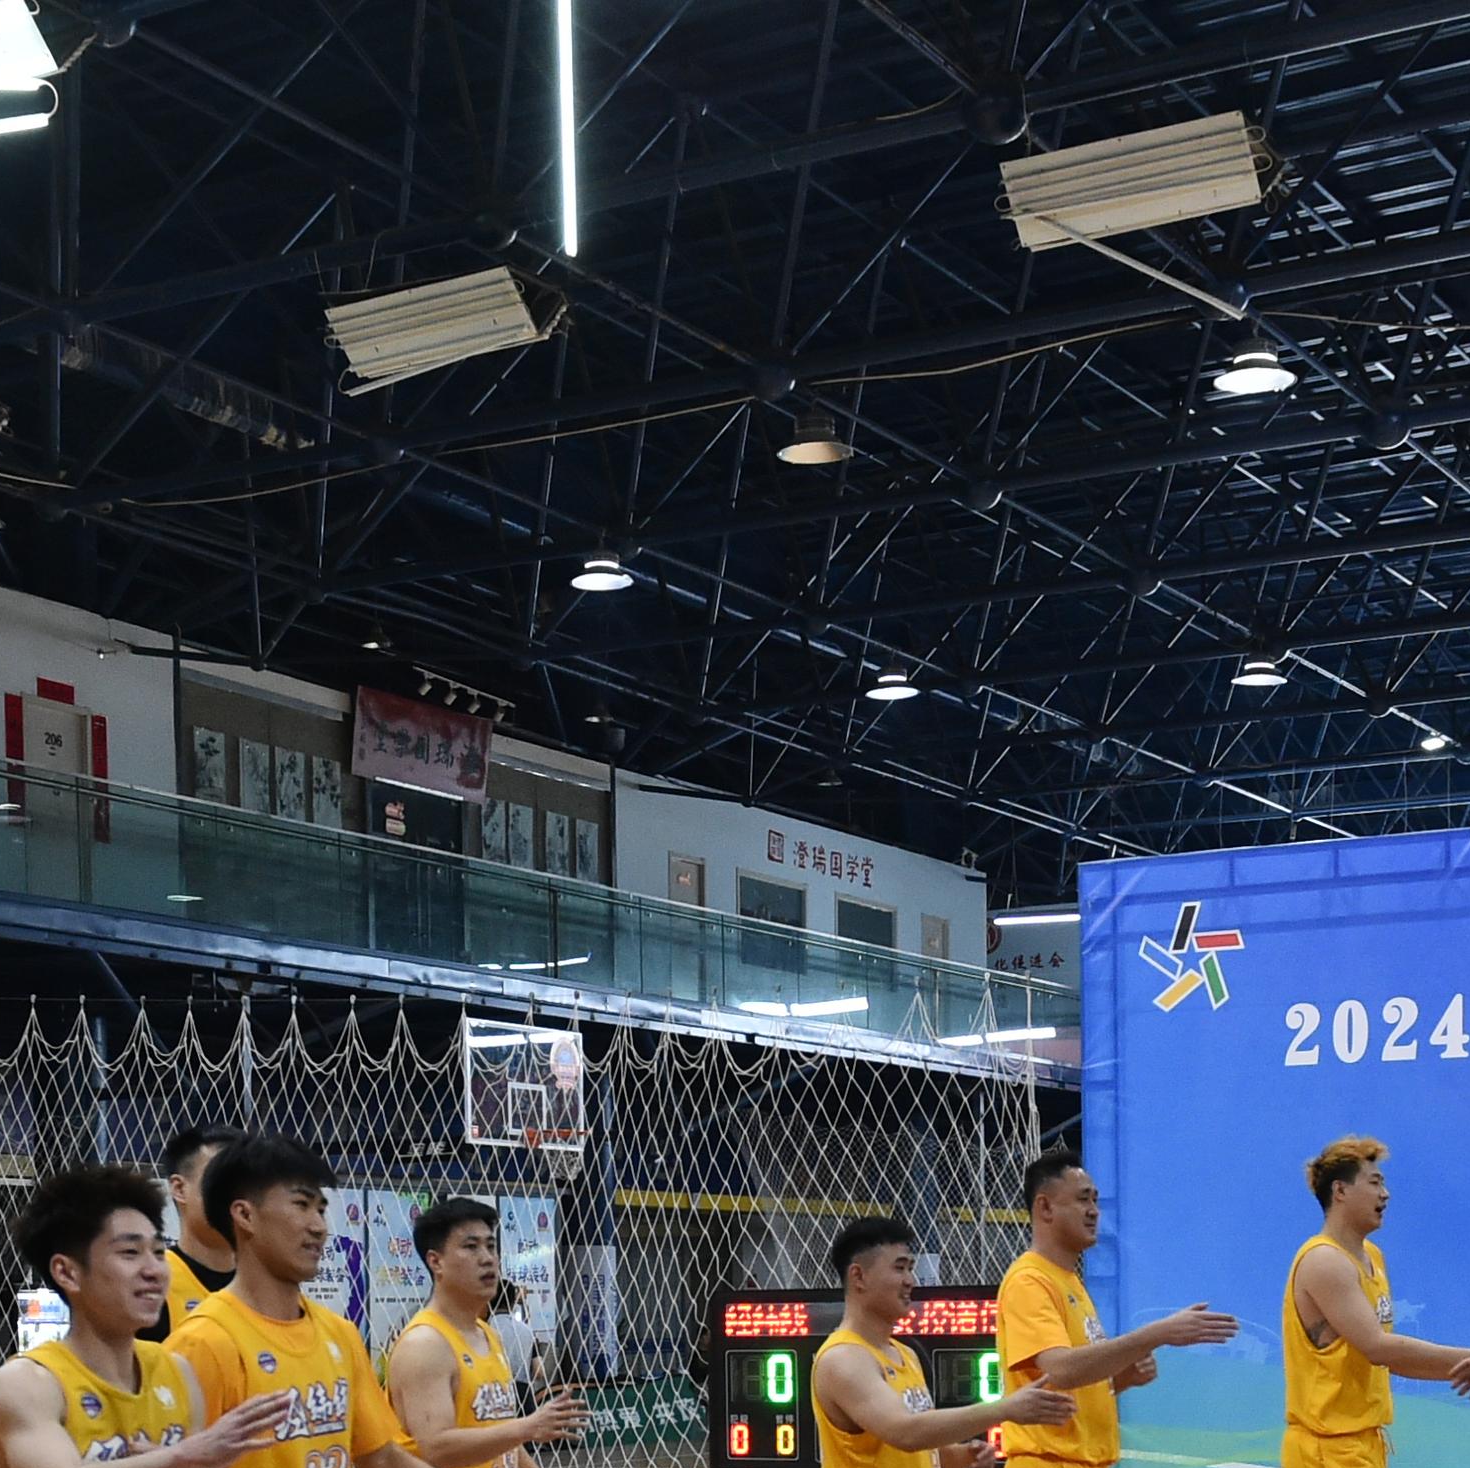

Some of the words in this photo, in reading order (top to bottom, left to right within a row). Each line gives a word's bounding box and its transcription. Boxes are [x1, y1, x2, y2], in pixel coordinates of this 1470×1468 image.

[44, 732, 63, 748] 206
[793, 840, 874, 888] 澄瑞国学堂
[767, 1352, 793, 1404] 0
[730, 1424, 750, 1456] 0
[776, 1424, 795, 1456] 0
